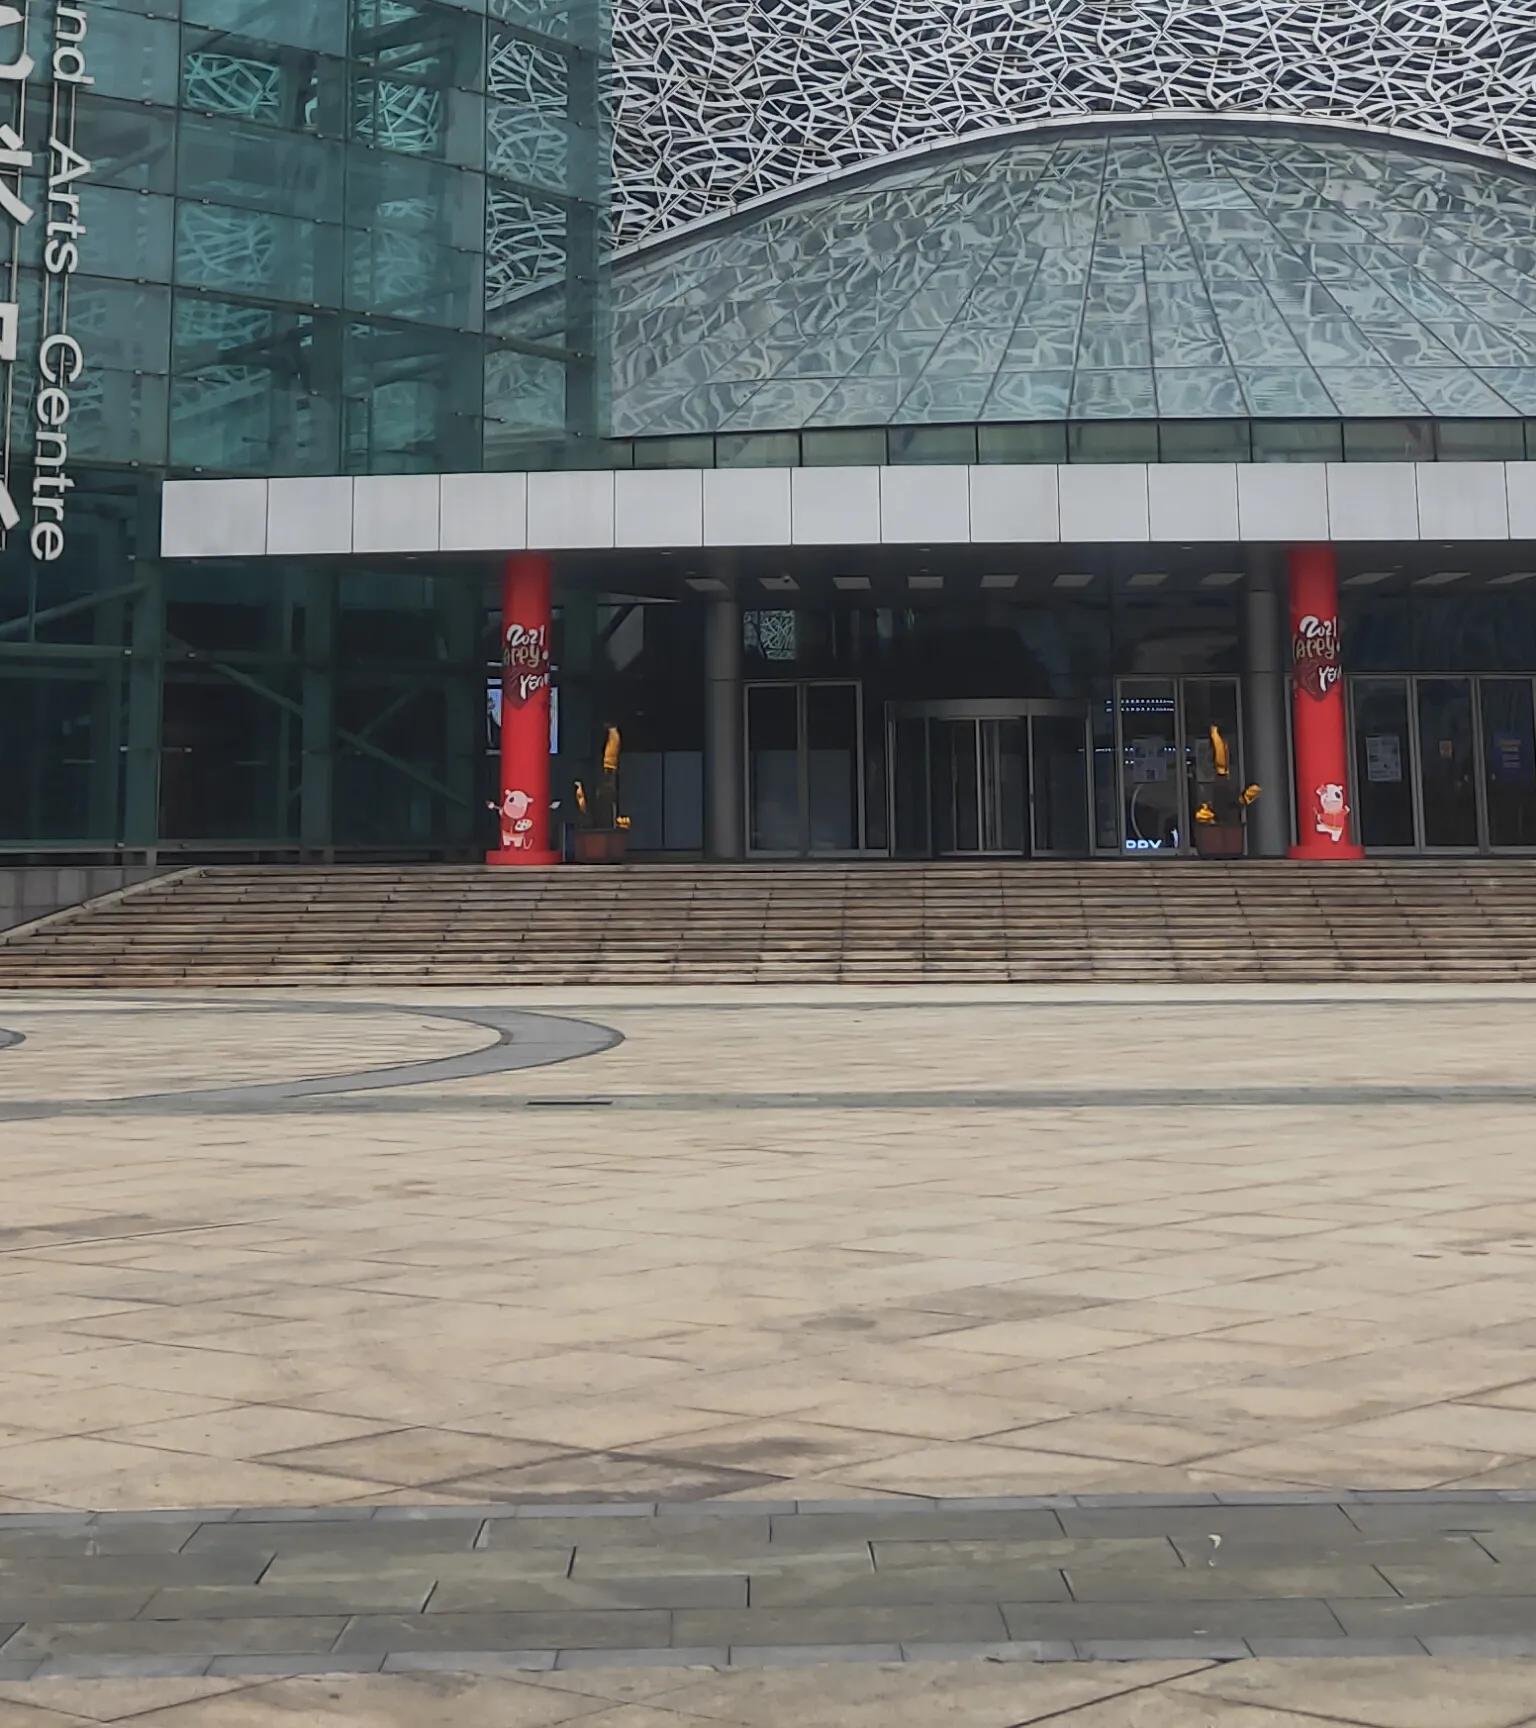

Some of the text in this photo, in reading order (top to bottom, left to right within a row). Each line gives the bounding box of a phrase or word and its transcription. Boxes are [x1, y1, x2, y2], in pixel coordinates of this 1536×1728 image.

[44, 136, 92, 275] Arts
[29, 333, 84, 562] Centre
[506, 624, 545, 647] 2021
[1300, 615, 1337, 639] 2021
